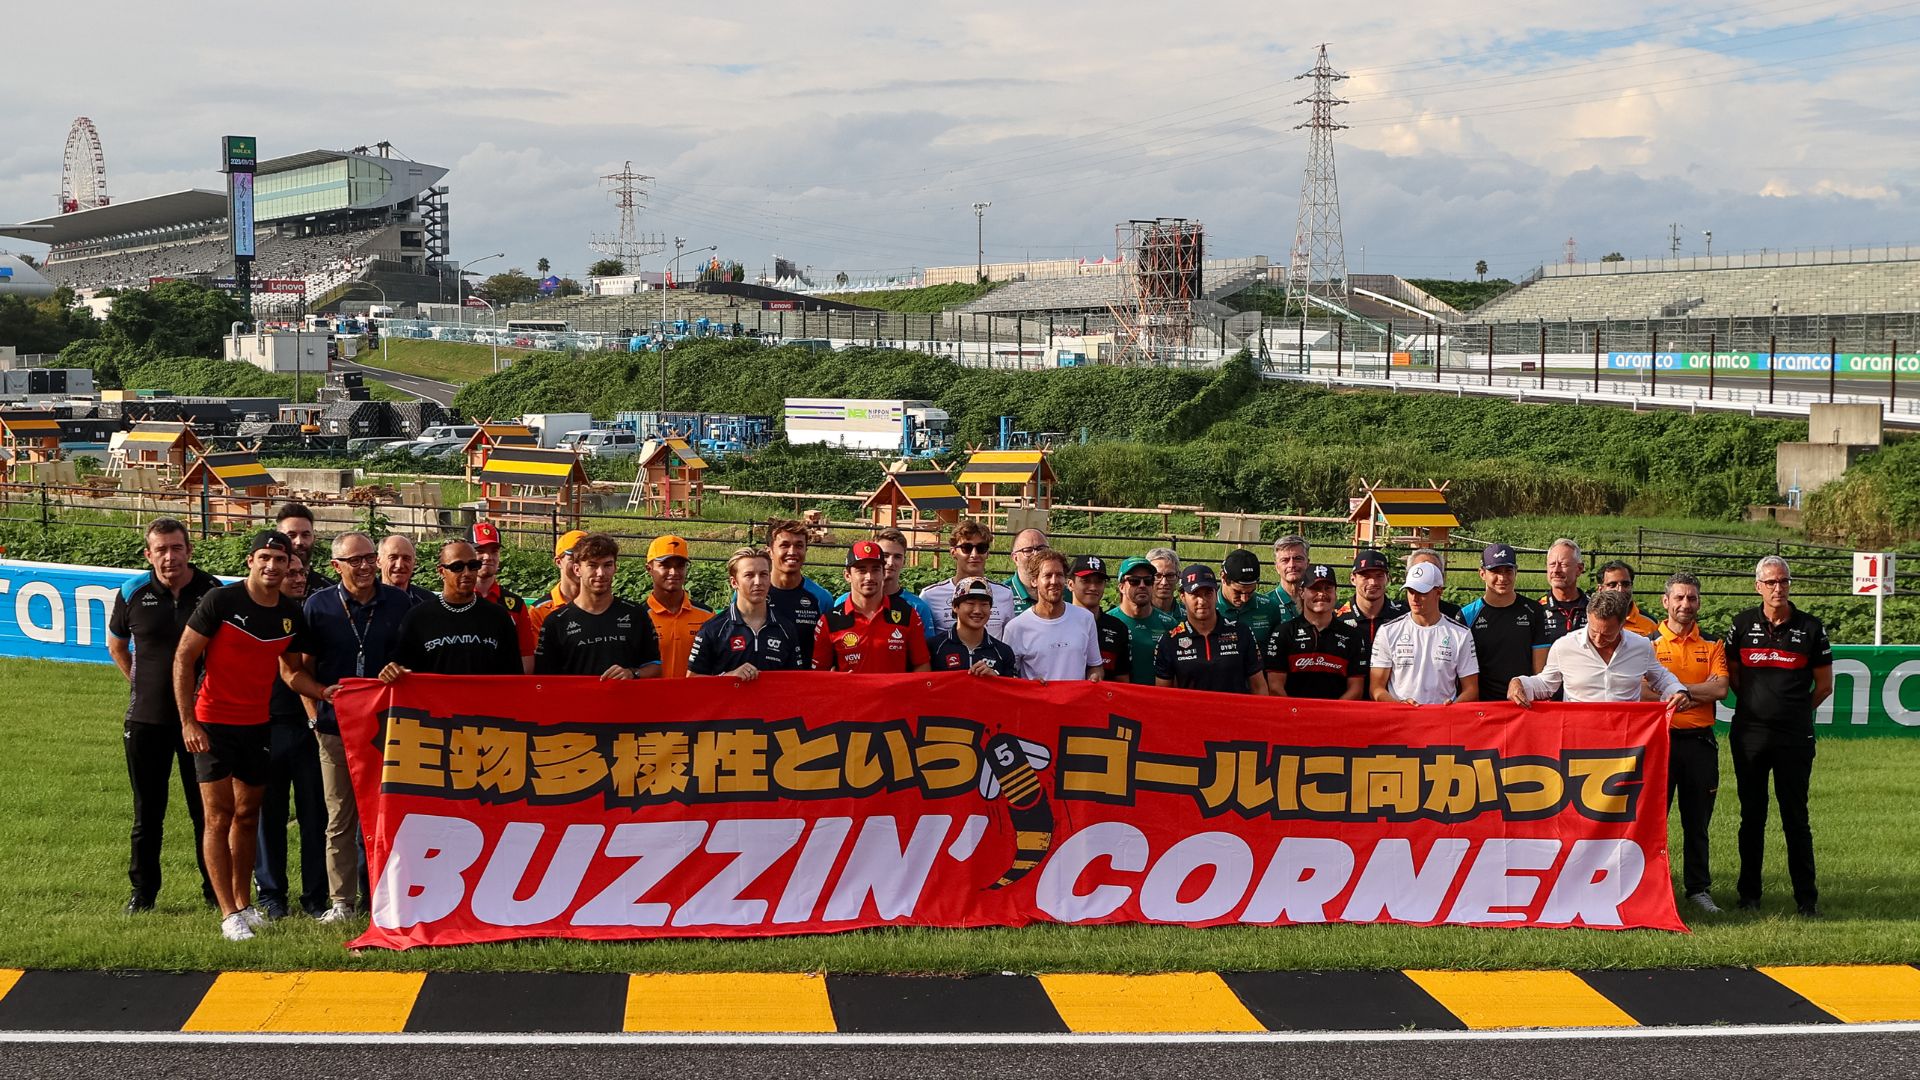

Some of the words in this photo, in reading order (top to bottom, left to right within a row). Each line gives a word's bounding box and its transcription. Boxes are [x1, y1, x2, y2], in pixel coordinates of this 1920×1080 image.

[271, 282, 304, 291] Lenovo
[1615, 354, 1673, 368] aramco
[1689, 354, 1750, 369] aramco
[1767, 355, 1832, 370] aramco
[1850, 356, 1920, 371] aramco
[424, 634, 481, 652] SORAYAMA
[577, 635, 626, 646] ALPINE
[844, 653, 861, 661] VGW
[1315, 656, 1342, 669] Romeo
[994, 743, 1015, 767] 5
[380, 714, 979, 798] 生物多様性という
[1060, 722, 1639, 816] ゴールに向かって
[372, 813, 989, 929] BUZZIN'
[1036, 821, 1646, 926] CORNER
